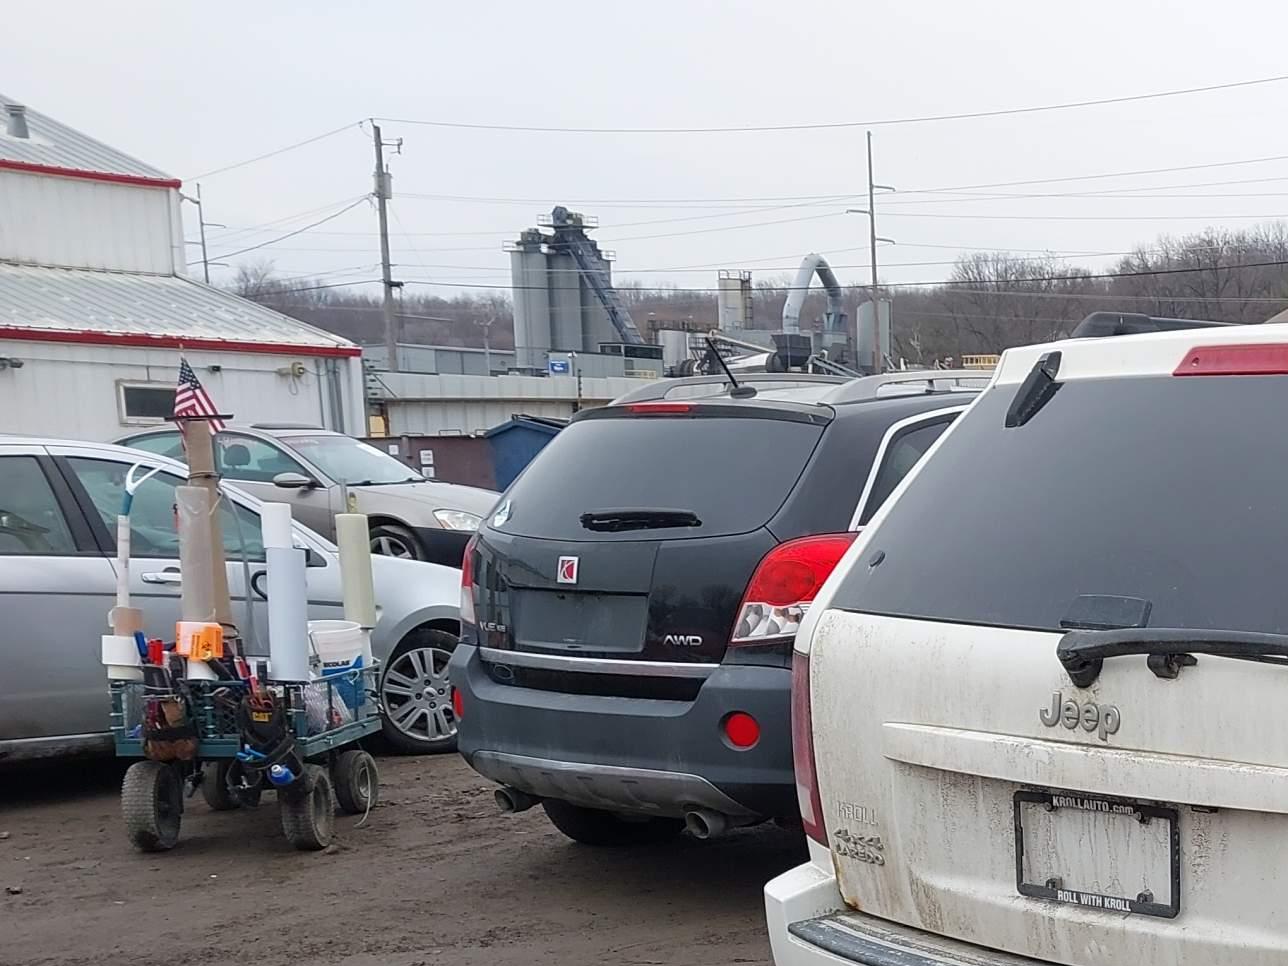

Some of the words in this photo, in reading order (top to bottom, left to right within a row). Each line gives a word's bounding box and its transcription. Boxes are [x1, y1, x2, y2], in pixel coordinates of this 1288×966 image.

[663, 634, 703, 646] AWD
[1039, 690, 1121, 742] Jeep
[1052, 795, 1135, 817] KROLLAUTO.com
[1056, 889, 1079, 904] ROLL
[1079, 892, 1103, 908] WITH
[1104, 896, 1132, 912] KROLL
